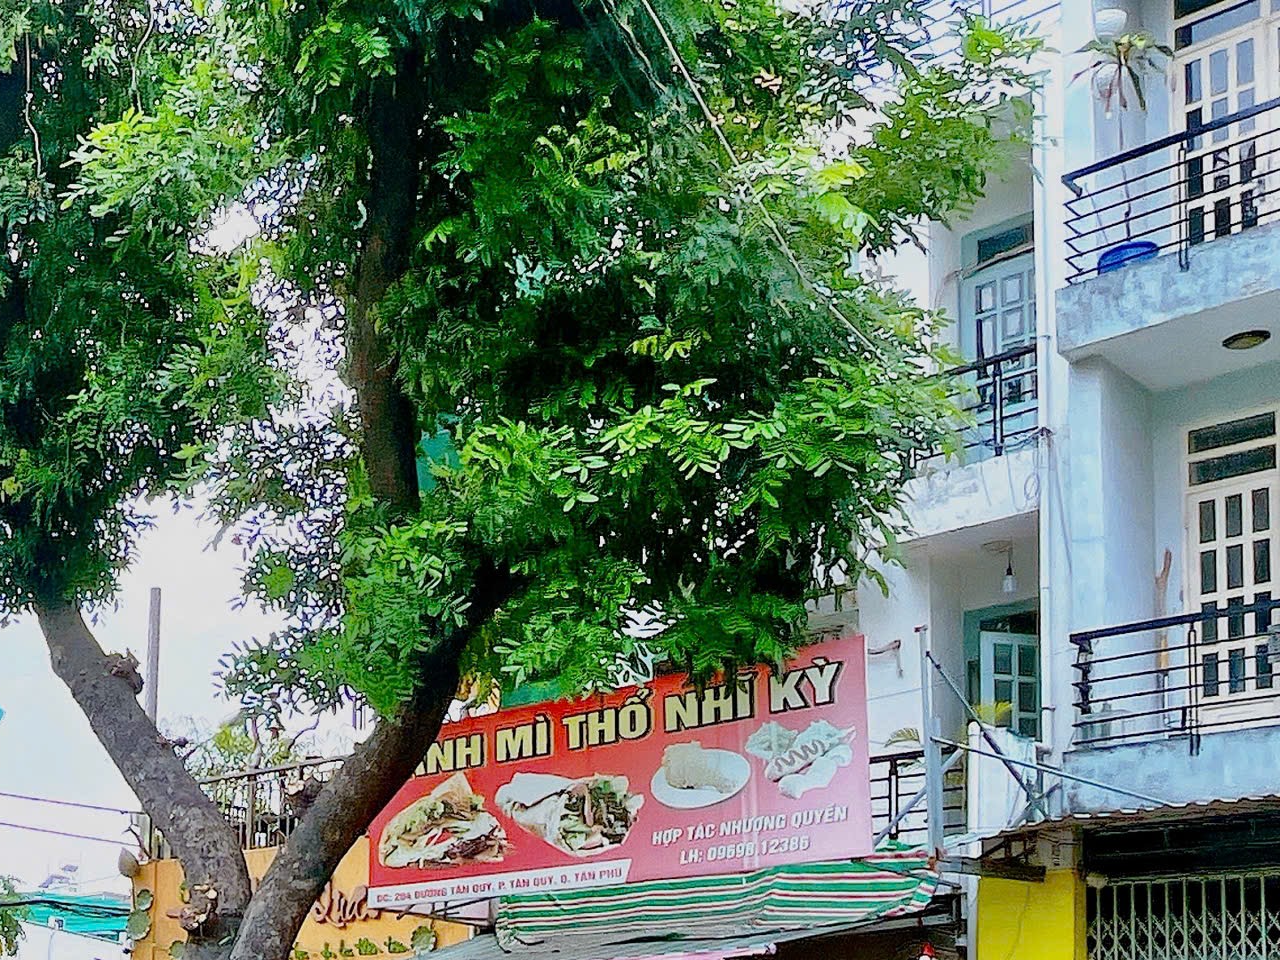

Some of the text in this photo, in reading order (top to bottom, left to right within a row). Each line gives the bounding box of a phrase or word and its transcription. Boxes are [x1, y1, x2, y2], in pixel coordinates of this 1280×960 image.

[415, 657, 844, 777] NH MÌ THỔ NHĨ KỲ
[652, 827, 683, 847] HỢP
[687, 822, 716, 842] TÁC
[679, 849, 703, 865] LH:
